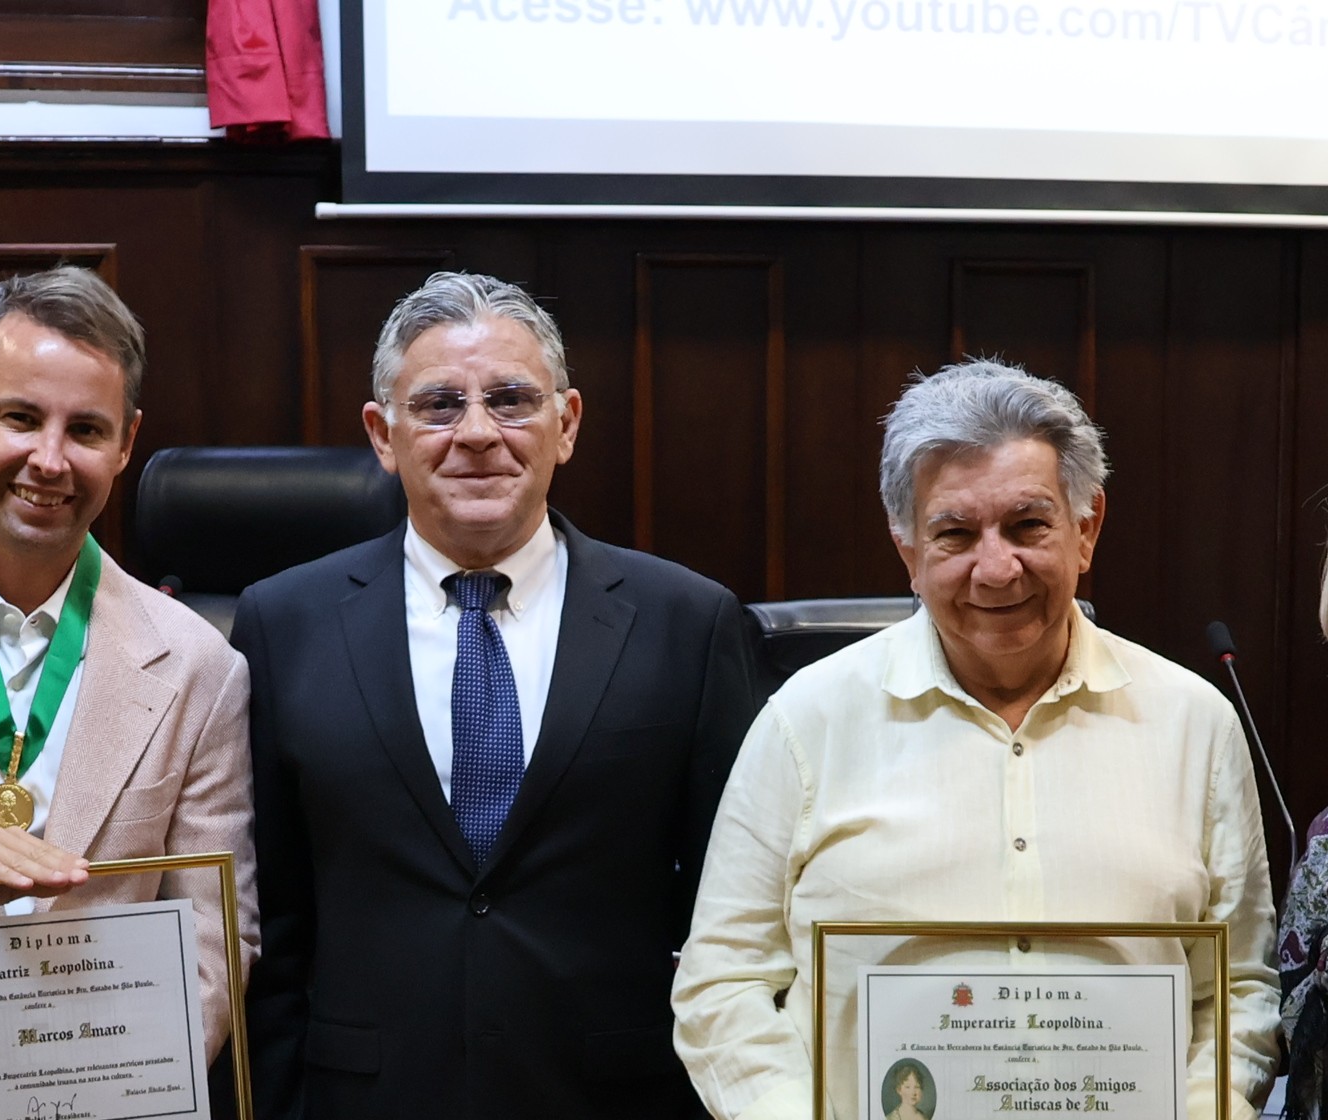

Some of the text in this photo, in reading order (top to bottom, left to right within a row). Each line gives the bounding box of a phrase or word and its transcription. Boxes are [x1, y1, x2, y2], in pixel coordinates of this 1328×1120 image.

[9, 933, 92, 950] Diploma
[39, 957, 115, 977] Leopoldina
[90, 984, 112, 993] Estado
[997, 986, 1083, 1002] Diploma
[939, 1013, 1104, 1031] Imperatriz Leopoldina
[17, 1022, 126, 1047] Marcos Amaro
[910, 1043, 937, 1051] Câmara
[1076, 1043, 1099, 1051] Estado
[3, 1070, 37, 1080] Imperatriz
[144, 1056, 174, 1067] prestados
[19, 1079, 56, 1090] comunidade
[972, 1075, 1137, 1094] Associação dos Amigos
[1065, 1097, 1081, 1111] de
[1083, 1094, 1109, 1112] Itu
